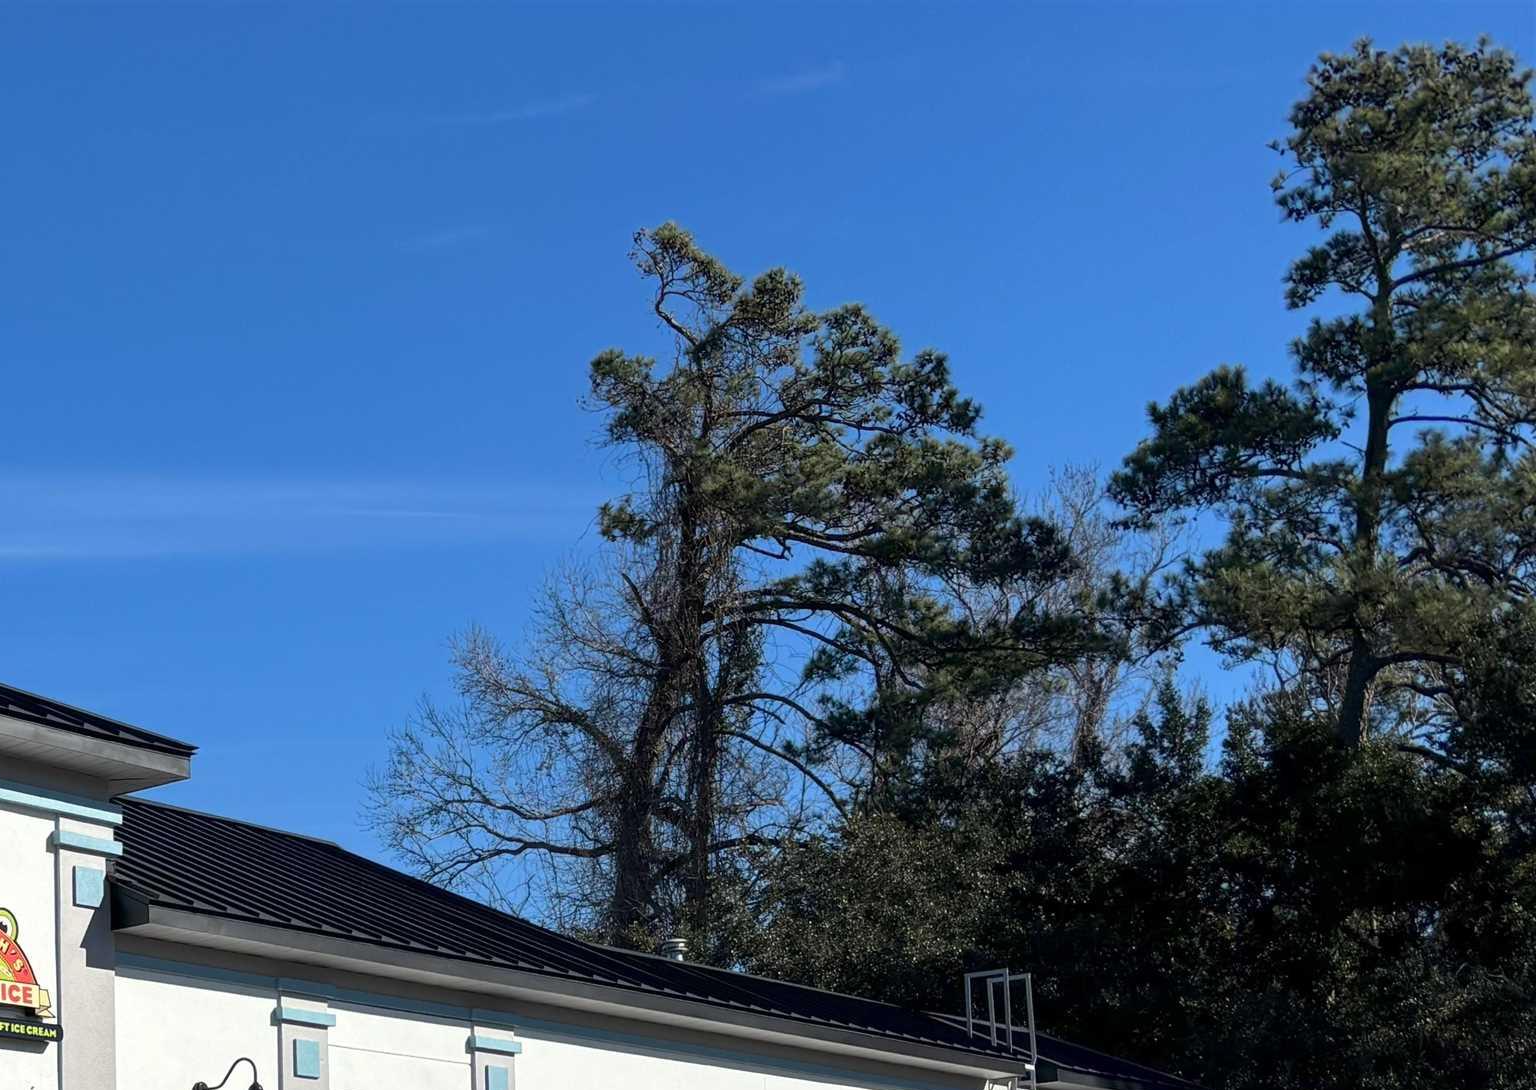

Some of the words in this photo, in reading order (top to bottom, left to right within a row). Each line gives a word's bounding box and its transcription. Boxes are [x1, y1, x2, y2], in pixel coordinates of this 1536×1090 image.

[1, 983, 33, 1005] ICE
[11, 1023, 26, 1034] ICE
[26, 1025, 57, 1038] CREAM
